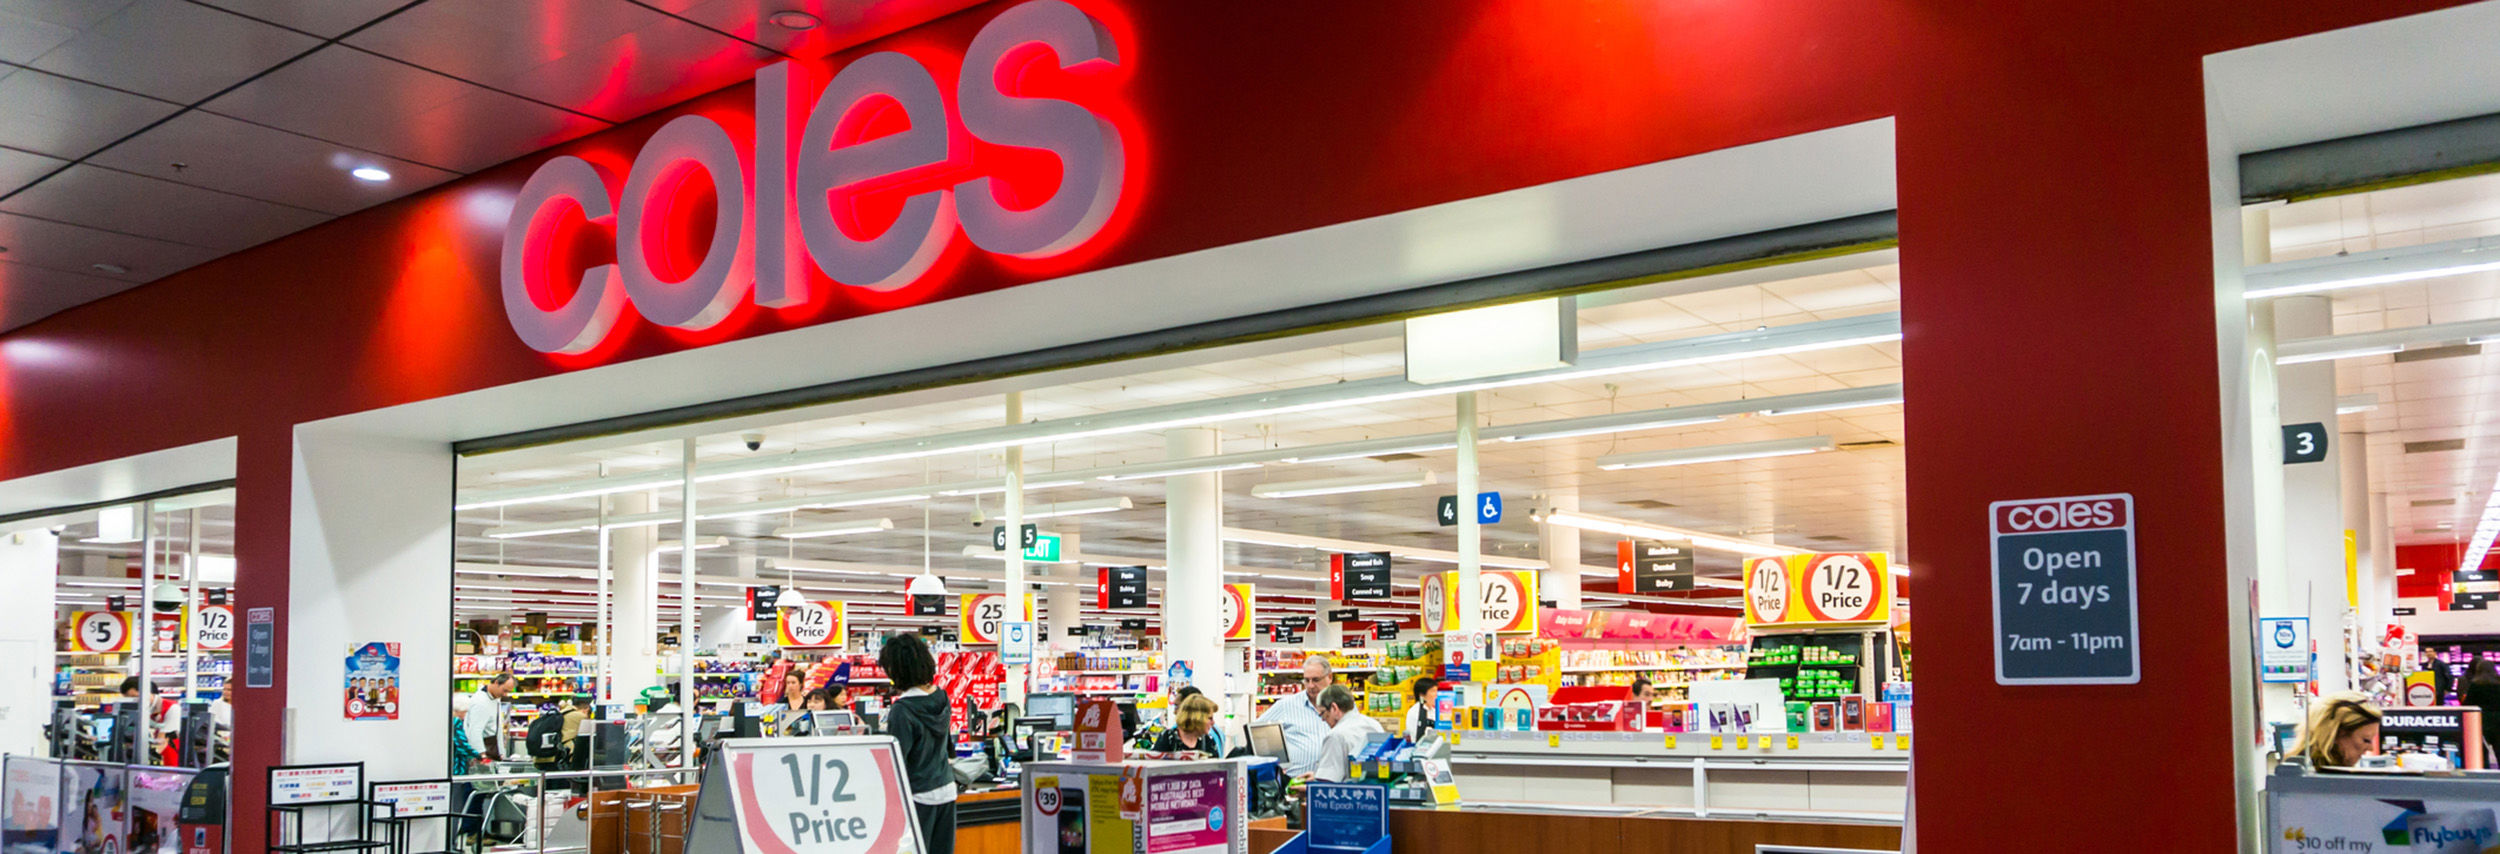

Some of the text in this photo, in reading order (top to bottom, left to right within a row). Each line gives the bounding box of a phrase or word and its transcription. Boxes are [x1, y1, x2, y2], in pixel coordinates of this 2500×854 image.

[501, 0, 1124, 355] coles
[2296, 431, 2315, 455] 3
[1443, 502, 1454, 519] 4
[2008, 500, 2115, 531] coles
[997, 531, 1005, 546] 6
[1025, 529, 1033, 544] 5
[1351, 559, 1372, 567] Canned
[1622, 562, 1631, 572] 4
[1652, 562, 1676, 572] Dental
[2023, 547, 2101, 576] Open
[1333, 573, 1340, 582] 5
[1360, 573, 1375, 581] Soup
[1656, 579, 1674, 588] Baby
[1758, 568, 1779, 593] 1/2
[1823, 564, 1861, 590] 1/2
[1100, 584, 1106, 593] 6
[1351, 588, 1383, 597] Canned veg
[1428, 584, 1440, 606] 1/2
[1481, 583, 1508, 604] /2
[2017, 579, 2111, 610] 7 days
[1758, 595, 1781, 611] Price
[1822, 592, 1862, 608] Price
[799, 608, 823, 626] 1/2
[982, 604, 1006, 620] 25
[1428, 607, 1440, 622] Price
[1481, 606, 1509, 621] rice
[200, 612, 227, 631] 1/2
[90, 621, 111, 643] $5
[199, 630, 228, 641] Price
[795, 626, 825, 637] Price
[2008, 634, 2052, 652] 7am
[2071, 632, 2124, 654] 11pm
[2410, 692, 2433, 701] Special
[2382, 715, 2459, 728] DURACELL
[781, 753, 856, 805] 1/2
[1040, 792, 1057, 805] $39
[1238, 777, 1246, 814] coles
[1313, 800, 1379, 811] The Epoch Times
[789, 810, 868, 845] Price
[2296, 836, 2373, 854] $10 off my
